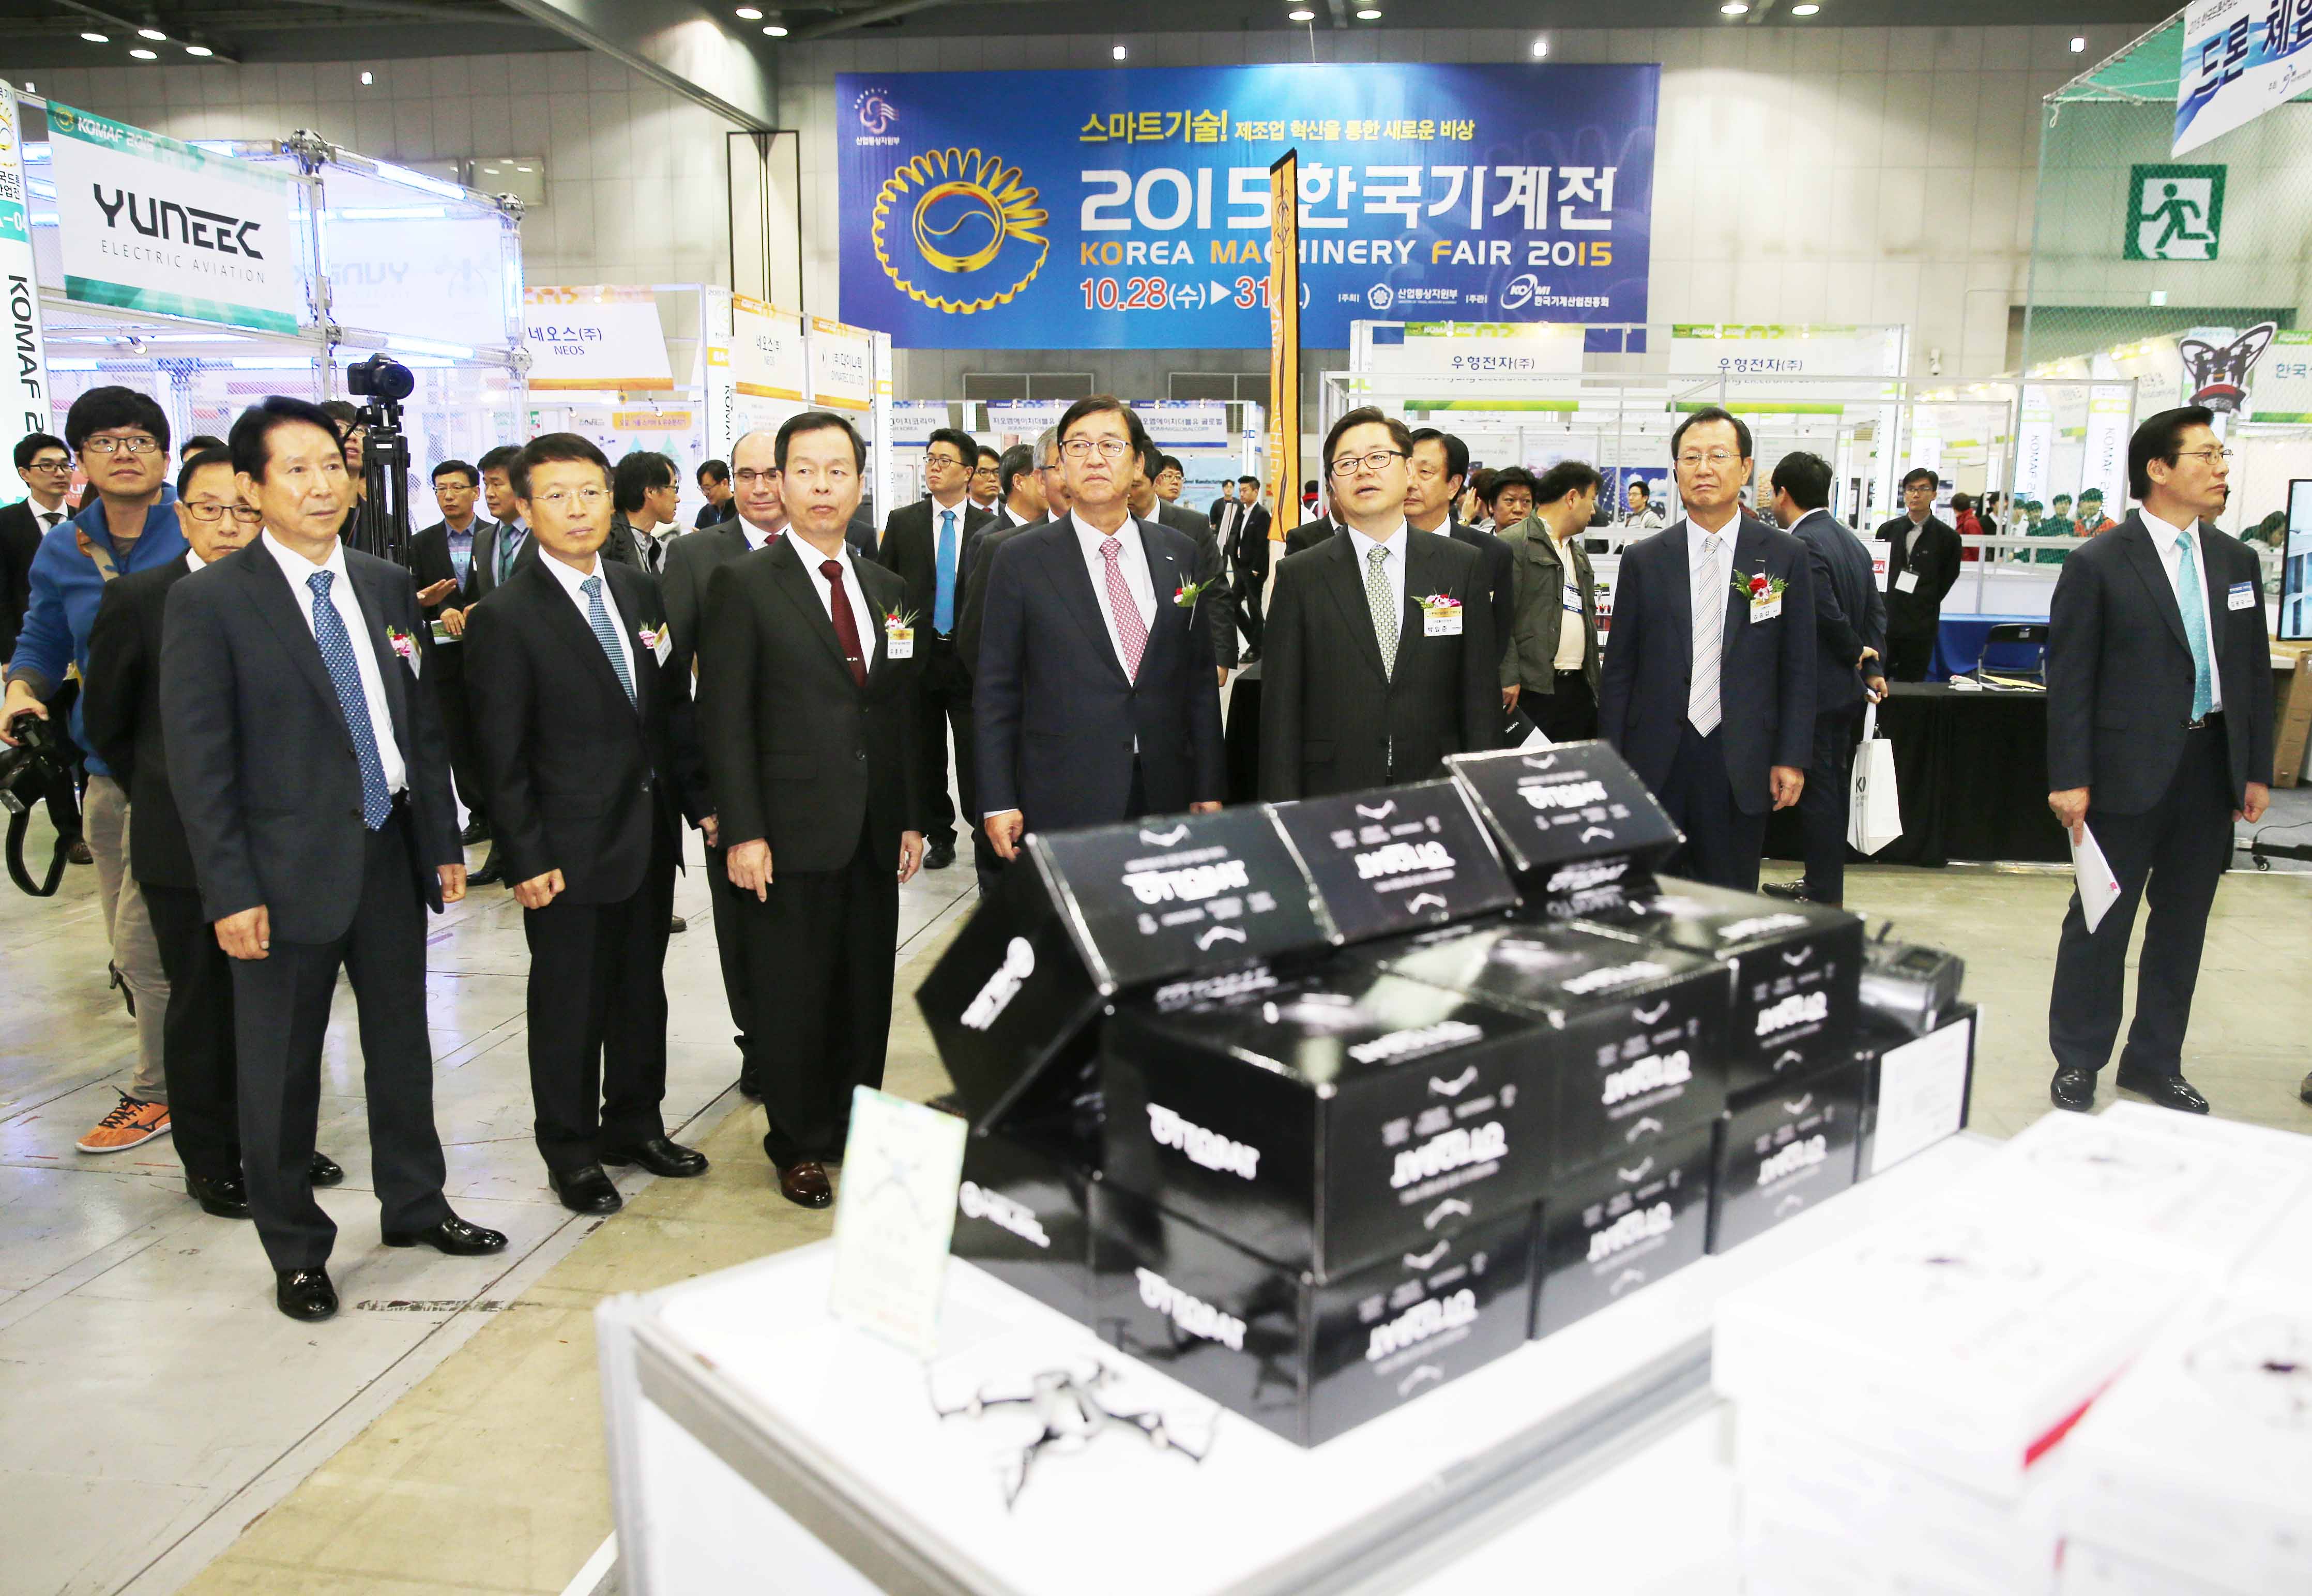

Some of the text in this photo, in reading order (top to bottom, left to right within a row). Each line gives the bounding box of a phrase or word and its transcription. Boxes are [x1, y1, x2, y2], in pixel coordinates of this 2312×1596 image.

[2195, 14, 2249, 96] 드론
[78, 116, 124, 143] KOMAF
[1079, 109, 1475, 144] 스마트기술! 제조업 혁신을 통한 새로운 비상
[94, 183, 264, 260] YUNEEC
[101, 240, 265, 284] ELECTRIC AVIATION
[1081, 240, 1195, 266] KOREA
[1432, 239, 1512, 266] FAIR
[1528, 239, 1613, 267] 2015
[8, 275, 41, 399] KOMAF
[528, 326, 602, 342] 네오스(주)
[554, 345, 585, 355] NEOS
[1451, 356, 1535, 370] 우형전자(주)
[1717, 358, 1803, 372] 우형전자(주)
[2277, 363, 2312, 379] 한국
